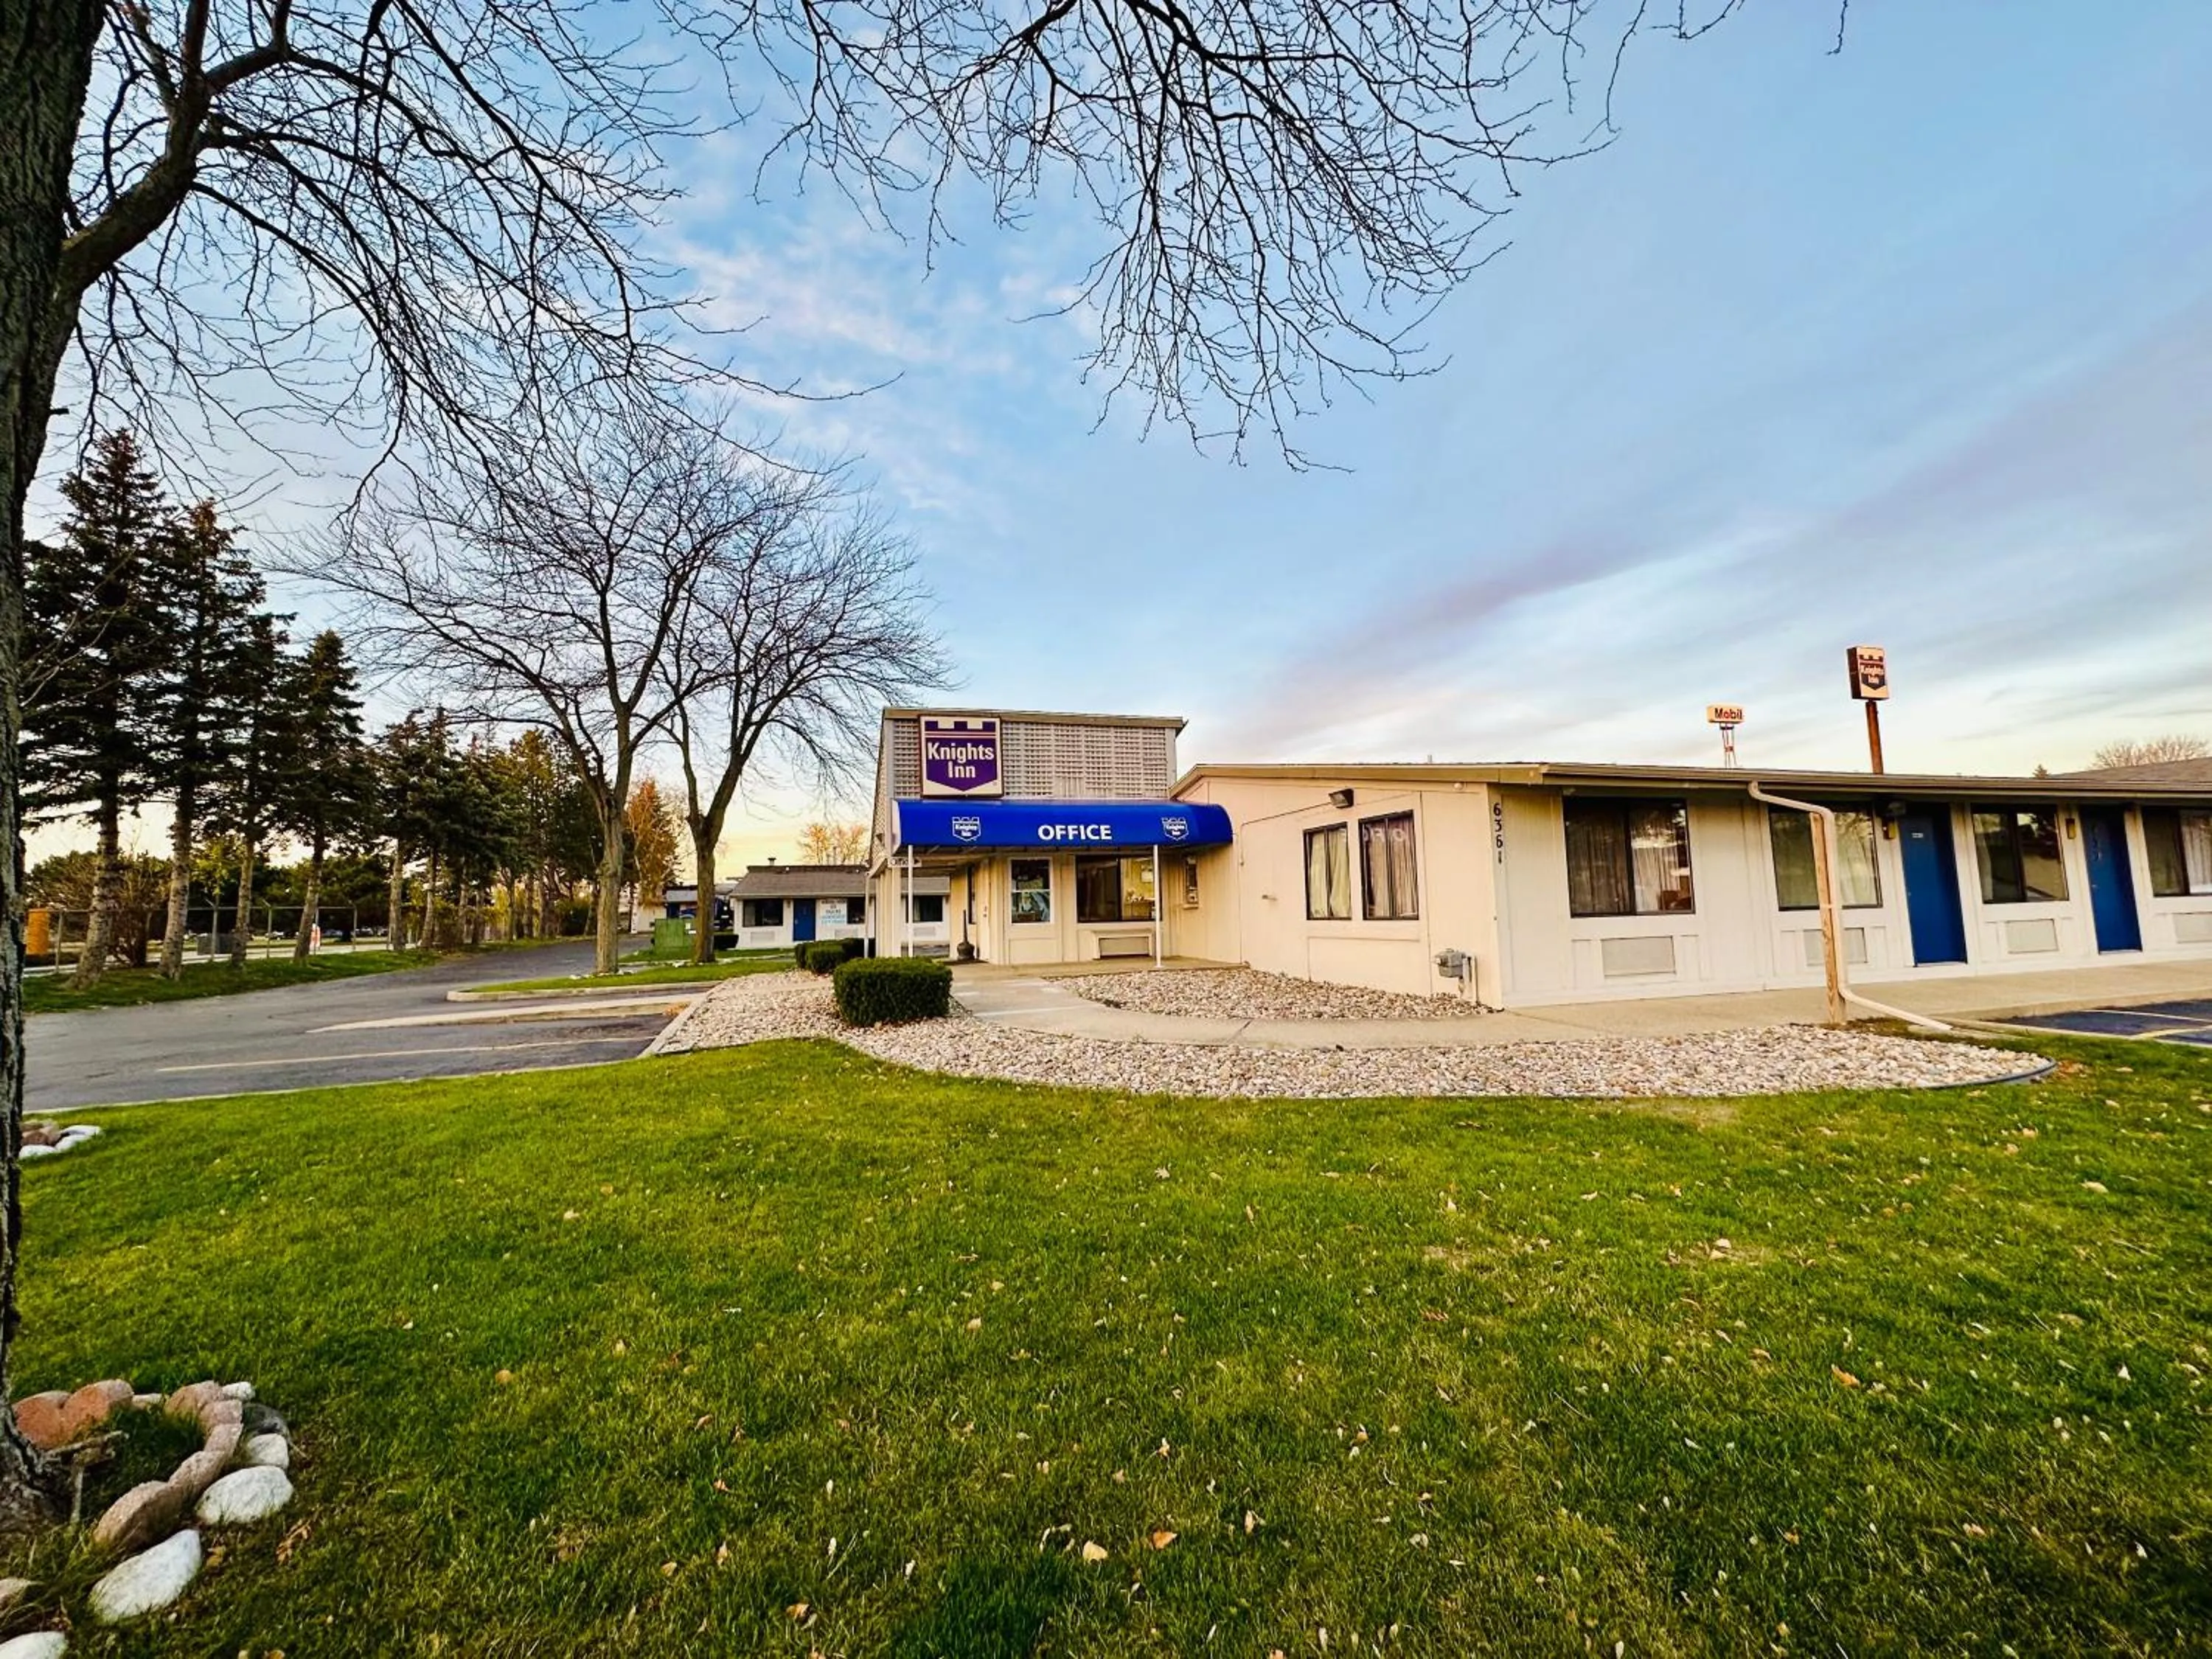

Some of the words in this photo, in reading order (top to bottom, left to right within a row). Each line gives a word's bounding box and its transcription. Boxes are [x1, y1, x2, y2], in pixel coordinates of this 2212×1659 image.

[1714, 707, 1743, 720] Mobil
[928, 742, 995, 763] Knights
[947, 761, 976, 778] Inn
[1037, 824, 1112, 840] OFFICE
[1493, 802, 1503, 864] 6361
